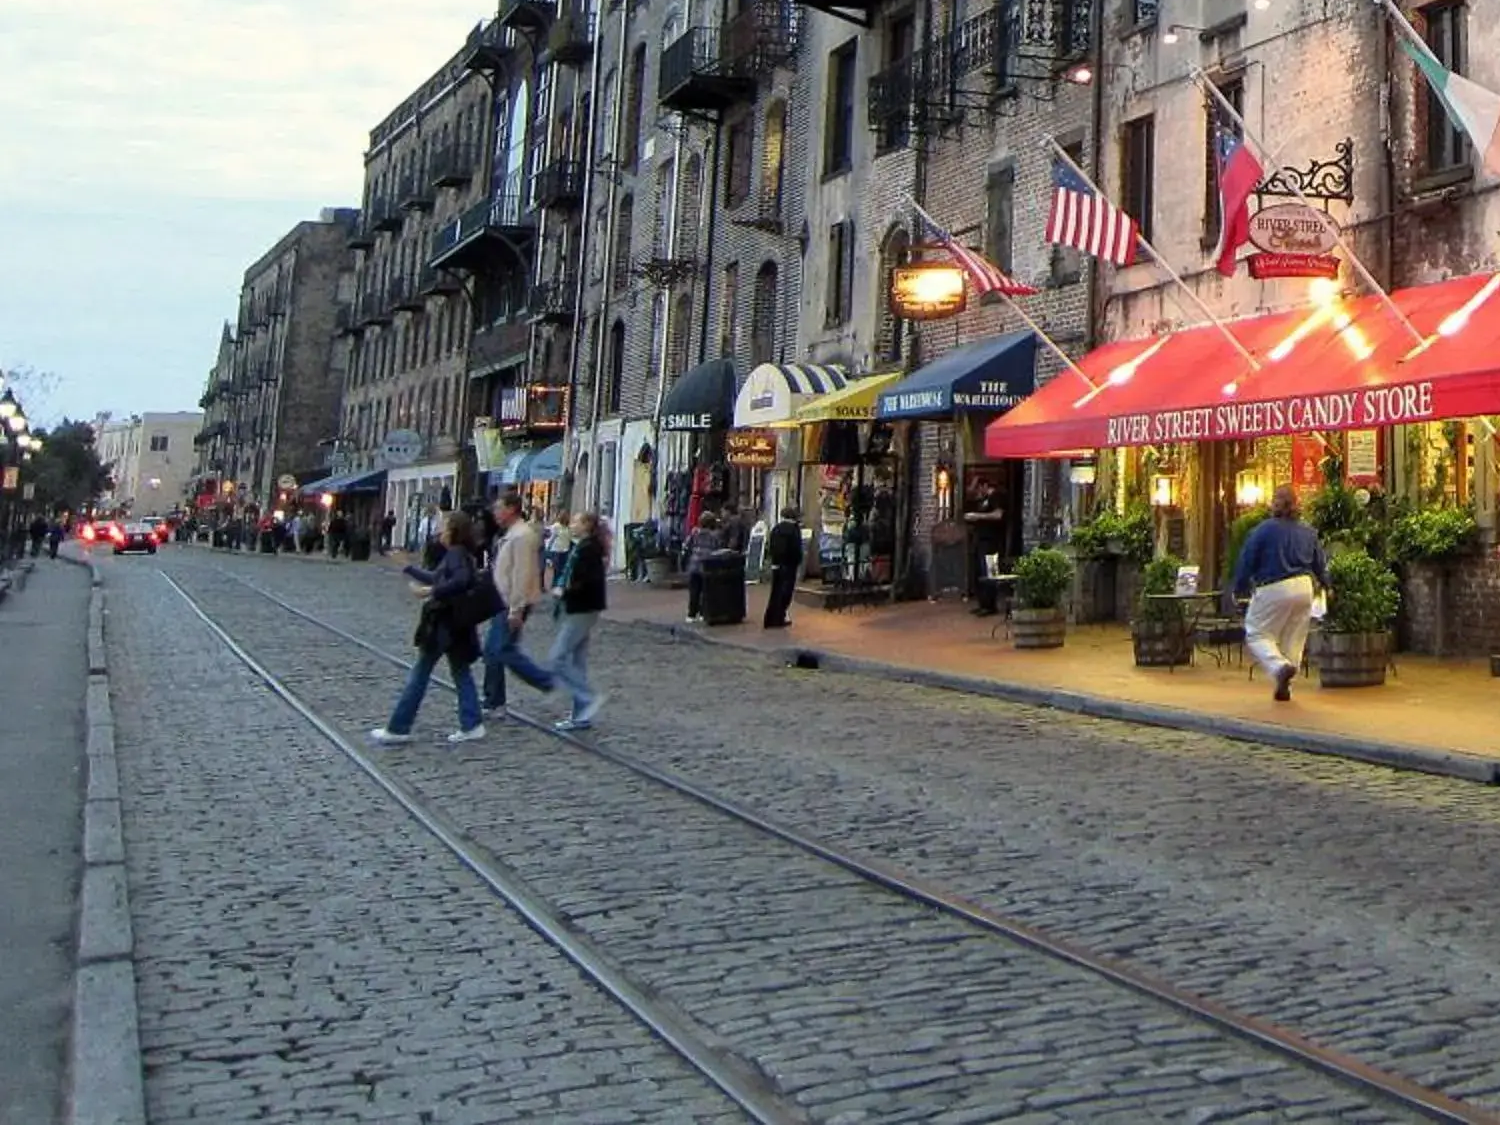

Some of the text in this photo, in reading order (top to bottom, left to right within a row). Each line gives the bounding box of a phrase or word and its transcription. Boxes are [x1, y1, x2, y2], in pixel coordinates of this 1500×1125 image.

[1257, 218, 1332, 234] RIVER STREE
[980, 380, 1009, 393] THE
[1107, 381, 1433, 444] RIVER STREET SWEETS CANDY STORE
[668, 413, 711, 428] SMILE
